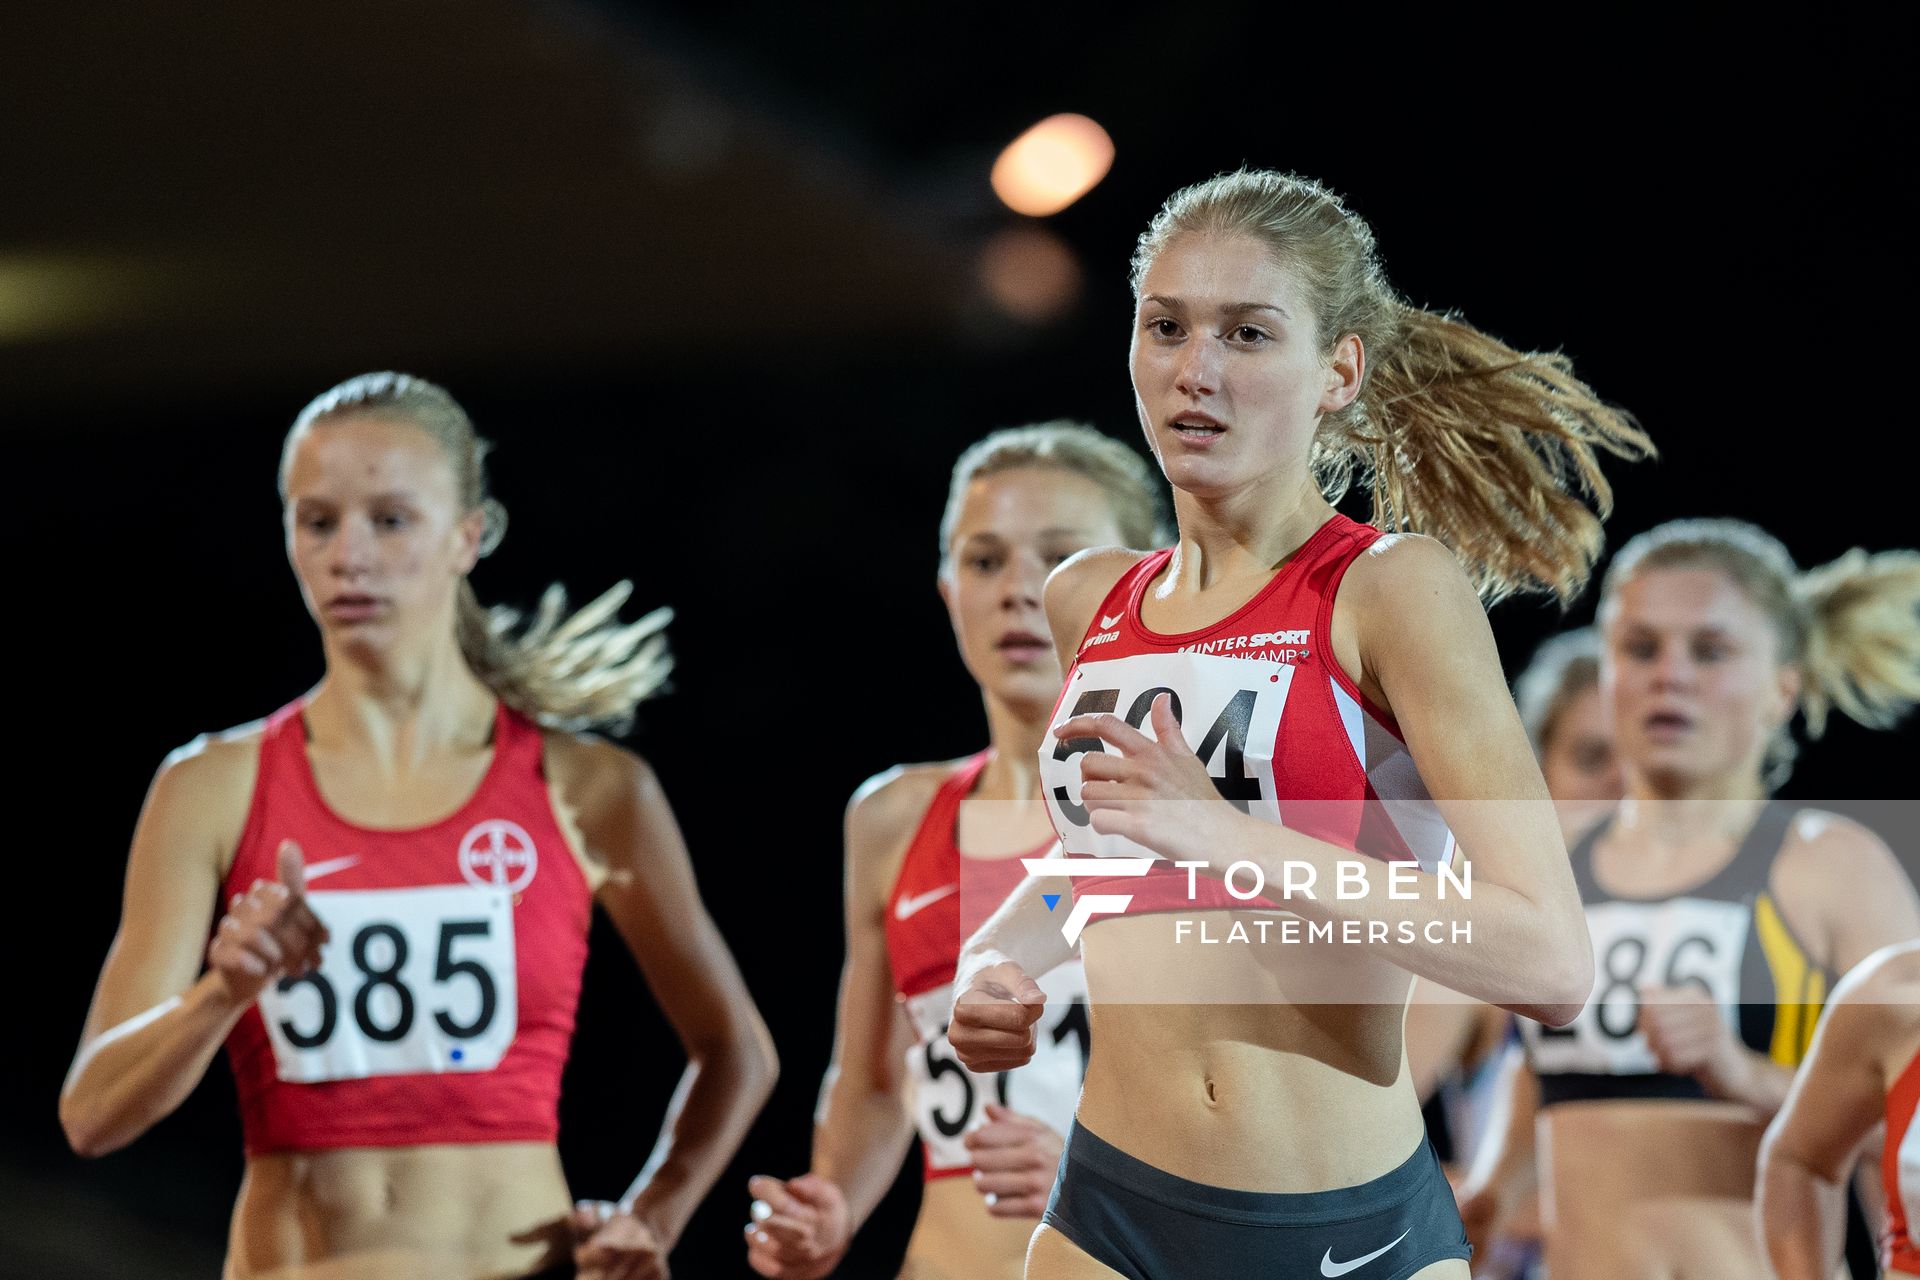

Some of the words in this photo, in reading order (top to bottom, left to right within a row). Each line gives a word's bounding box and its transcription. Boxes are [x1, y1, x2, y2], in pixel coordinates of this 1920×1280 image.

[276, 921, 498, 1049] 585
[1540, 936, 1716, 1040] 86
[926, 996, 1090, 1137] 51
